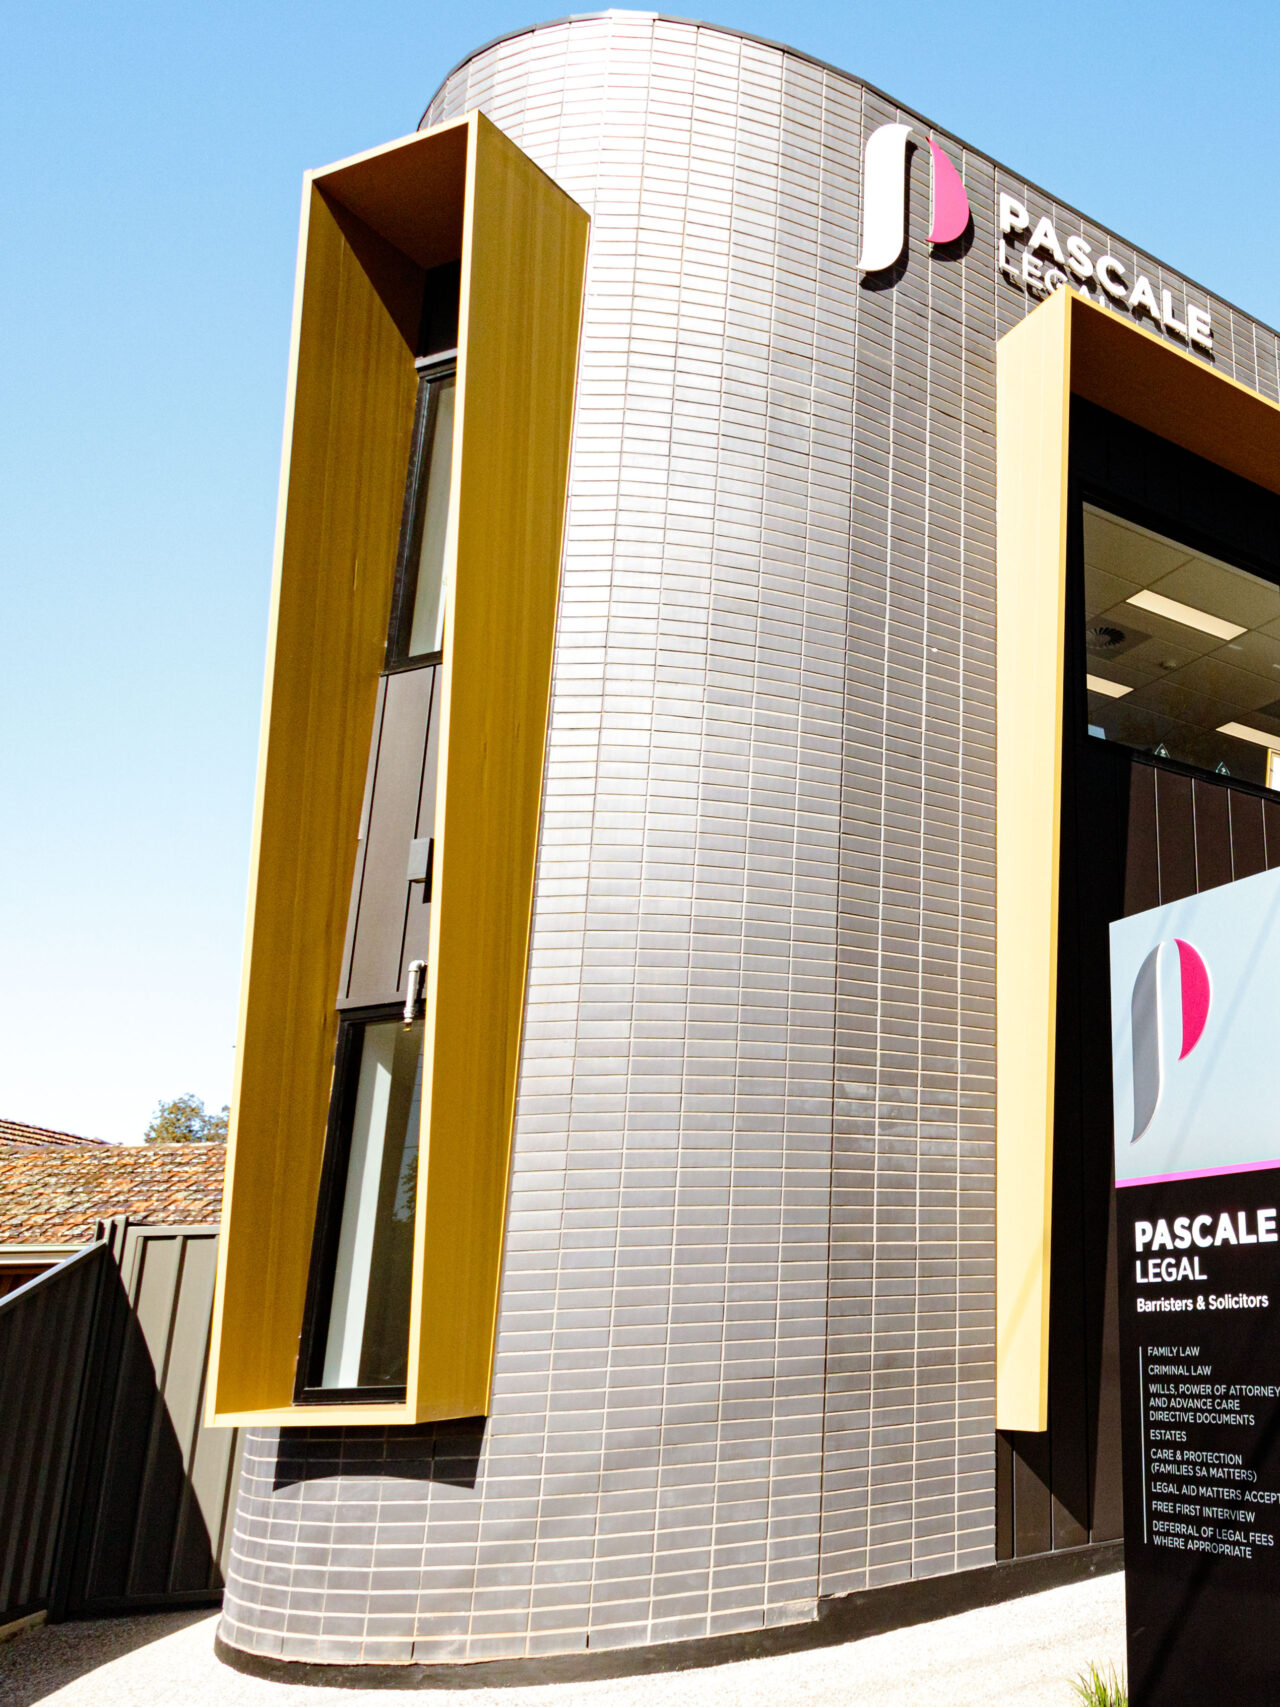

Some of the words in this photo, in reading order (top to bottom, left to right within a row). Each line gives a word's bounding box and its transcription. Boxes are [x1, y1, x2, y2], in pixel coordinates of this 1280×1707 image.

[999, 239, 1106, 307] LEG
[1000, 191, 1213, 349] PASCALE
[1135, 1208, 1279, 1252] PASCALE
[1136, 1256, 1208, 1284] LEGAL
[1136, 1297, 1194, 1313] Barristers
[1196, 1295, 1206, 1310] &
[1208, 1293, 1269, 1310] Solicitors
[1148, 1346, 1178, 1357] FAMILY
[1179, 1346, 1200, 1356] LAW
[1148, 1365, 1189, 1376] CRIMINAL
[1191, 1365, 1212, 1376] LAW
[1149, 1384, 1178, 1395] WILLS,
[1179, 1384, 1212, 1395] POWER
[1214, 1385, 1227, 1396] OF
[1229, 1385, 1280, 1397] ATTORNEY
[1149, 1397, 1168, 1408] AND
[1169, 1398, 1212, 1410] ADVANCE
[1214, 1399, 1240, 1411] CARE
[1149, 1411, 1195, 1423] DIRECTIVE
[1196, 1413, 1255, 1426] DOCUMENTS
[1150, 1429, 1187, 1442] ESTATES
[1151, 1448, 1174, 1460] CARE
[1175, 1450, 1182, 1461] &
[1183, 1450, 1242, 1465] PROTECTION
[1151, 1463, 1194, 1476] (FAMILIES
[1195, 1466, 1208, 1477] SA
[1209, 1467, 1258, 1483] MATTERS)
[1151, 1481, 1179, 1495] LEGAL
[1181, 1484, 1197, 1496] AID
[1199, 1486, 1242, 1500] MATTERS
[1152, 1501, 1174, 1514] FREE
[1176, 1503, 1201, 1517] FIRST
[1202, 1506, 1255, 1523] INTERVIEW
[1152, 1520, 1199, 1537] DEFERRAL
[1201, 1526, 1214, 1538] OF
[1216, 1528, 1247, 1543] LEGAL
[1249, 1532, 1274, 1547] FEES
[1153, 1534, 1185, 1549] WHERE
[1187, 1539, 1252, 1559] APPROPRIATE
